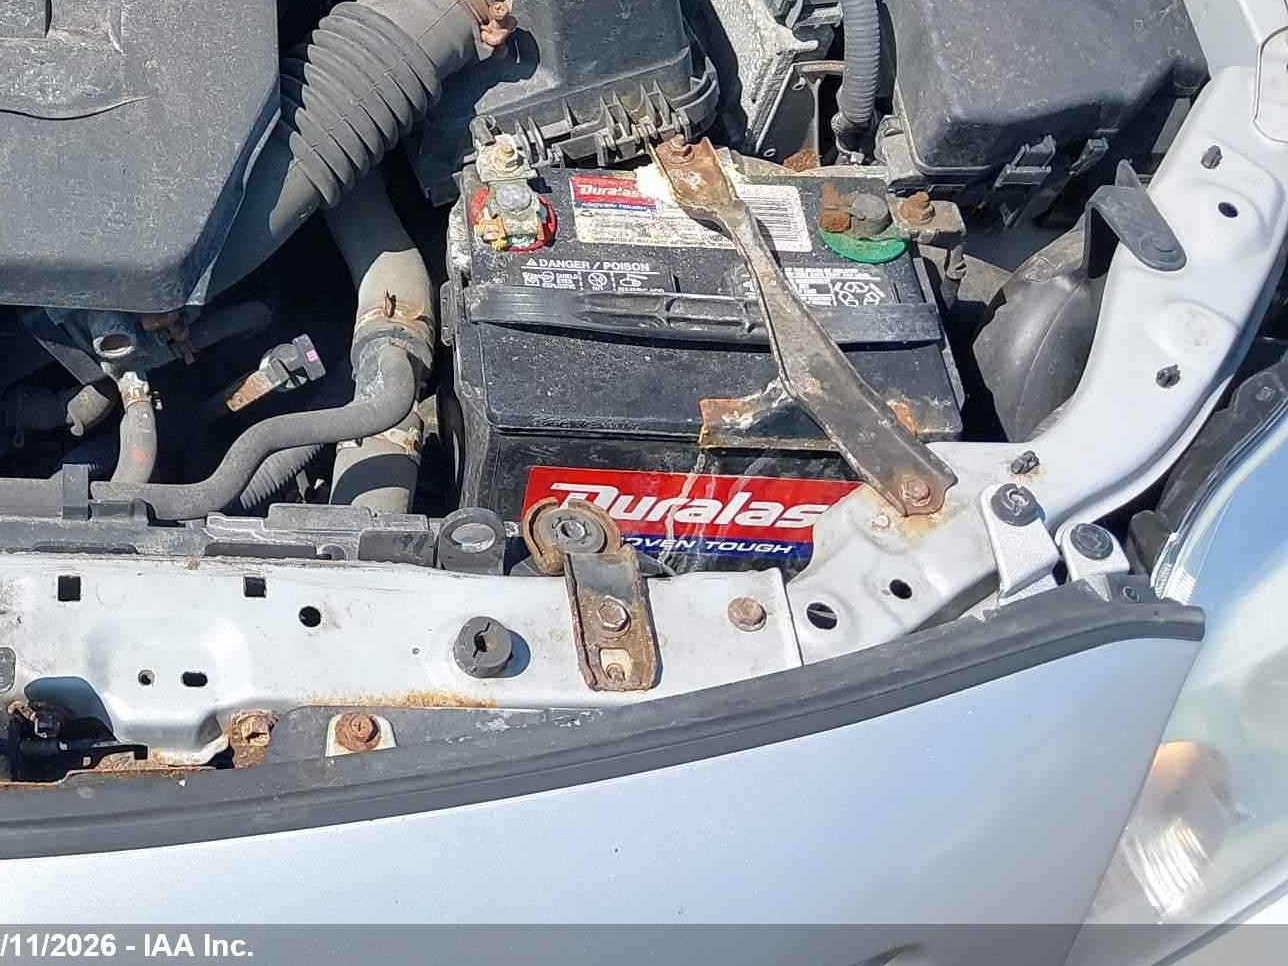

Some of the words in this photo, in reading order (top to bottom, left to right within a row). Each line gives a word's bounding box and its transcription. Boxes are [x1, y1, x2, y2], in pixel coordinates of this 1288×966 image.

[539, 259, 591, 269] DANGER
[603, 262, 650, 271] POISON
[705, 541, 794, 555] TOUGH
